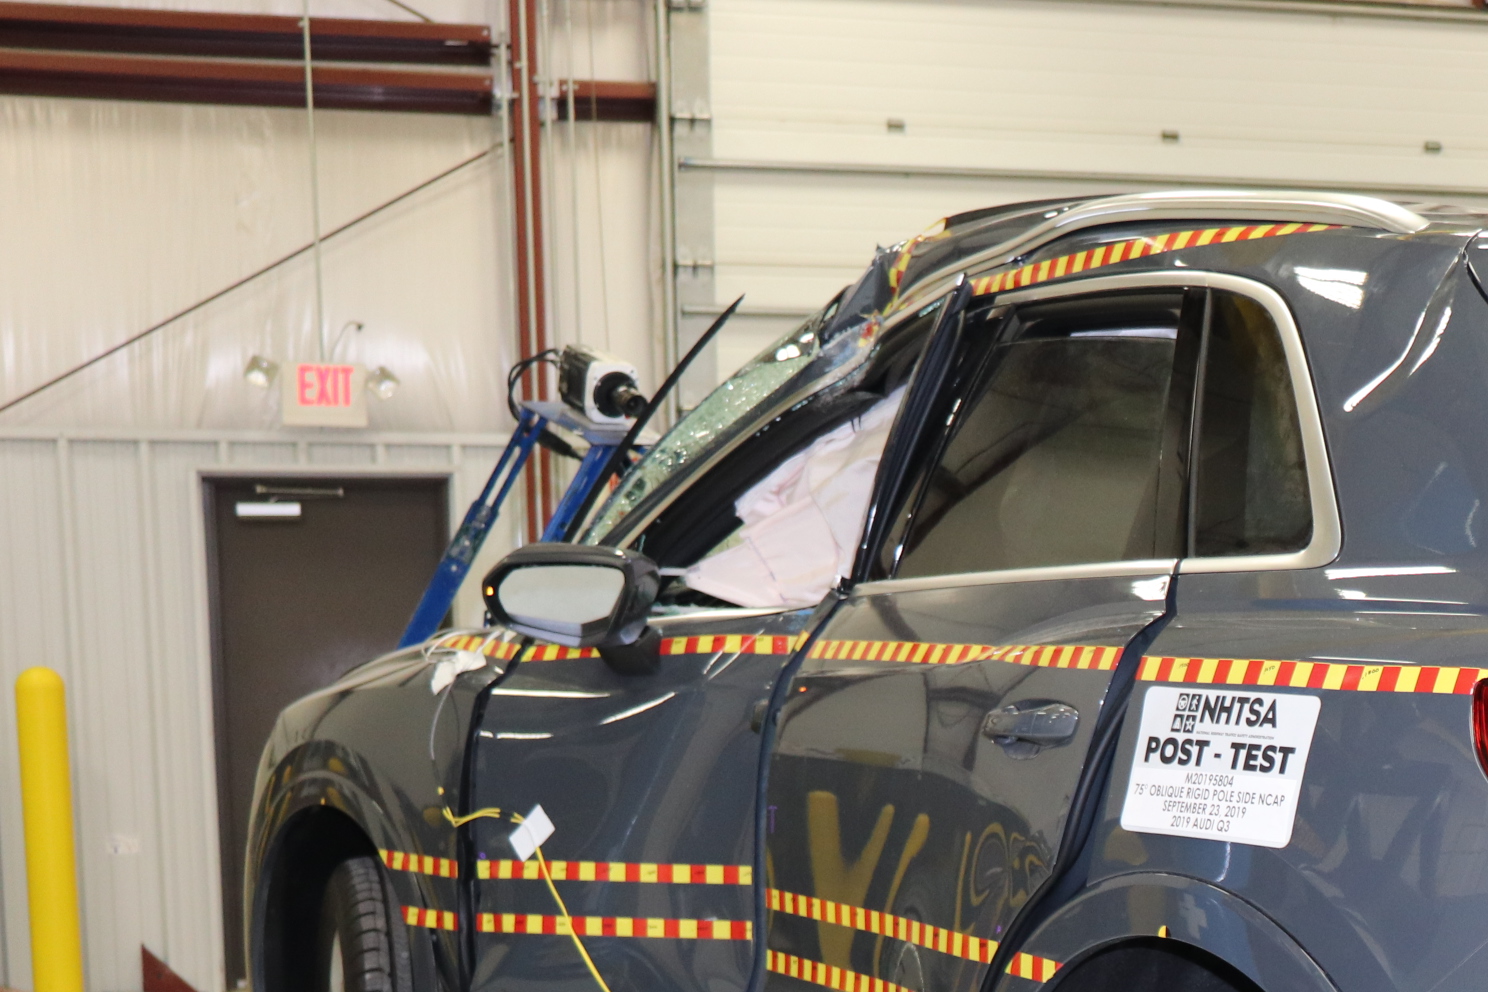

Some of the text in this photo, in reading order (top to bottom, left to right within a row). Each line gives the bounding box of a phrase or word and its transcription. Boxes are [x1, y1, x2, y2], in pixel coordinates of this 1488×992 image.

[297, 363, 354, 407] EXIT
[1199, 694, 1277, 728] NHTSA
[1144, 736, 1211, 767] POST
[1230, 742, 1297, 775] TEST
[1184, 772, 1235, 787] M20195804
[1149, 785, 1185, 799] OBLIQUE
[1185, 788, 1210, 800] RIGID
[1211, 790, 1235, 802] POLE
[1235, 792, 1257, 804] SIDE
[1258, 793, 1286, 807] NCAP
[1162, 800, 1247, 819] SEPTEMBER 23, 2019
[1170, 815, 1231, 833] 2019 AUDI Q3
